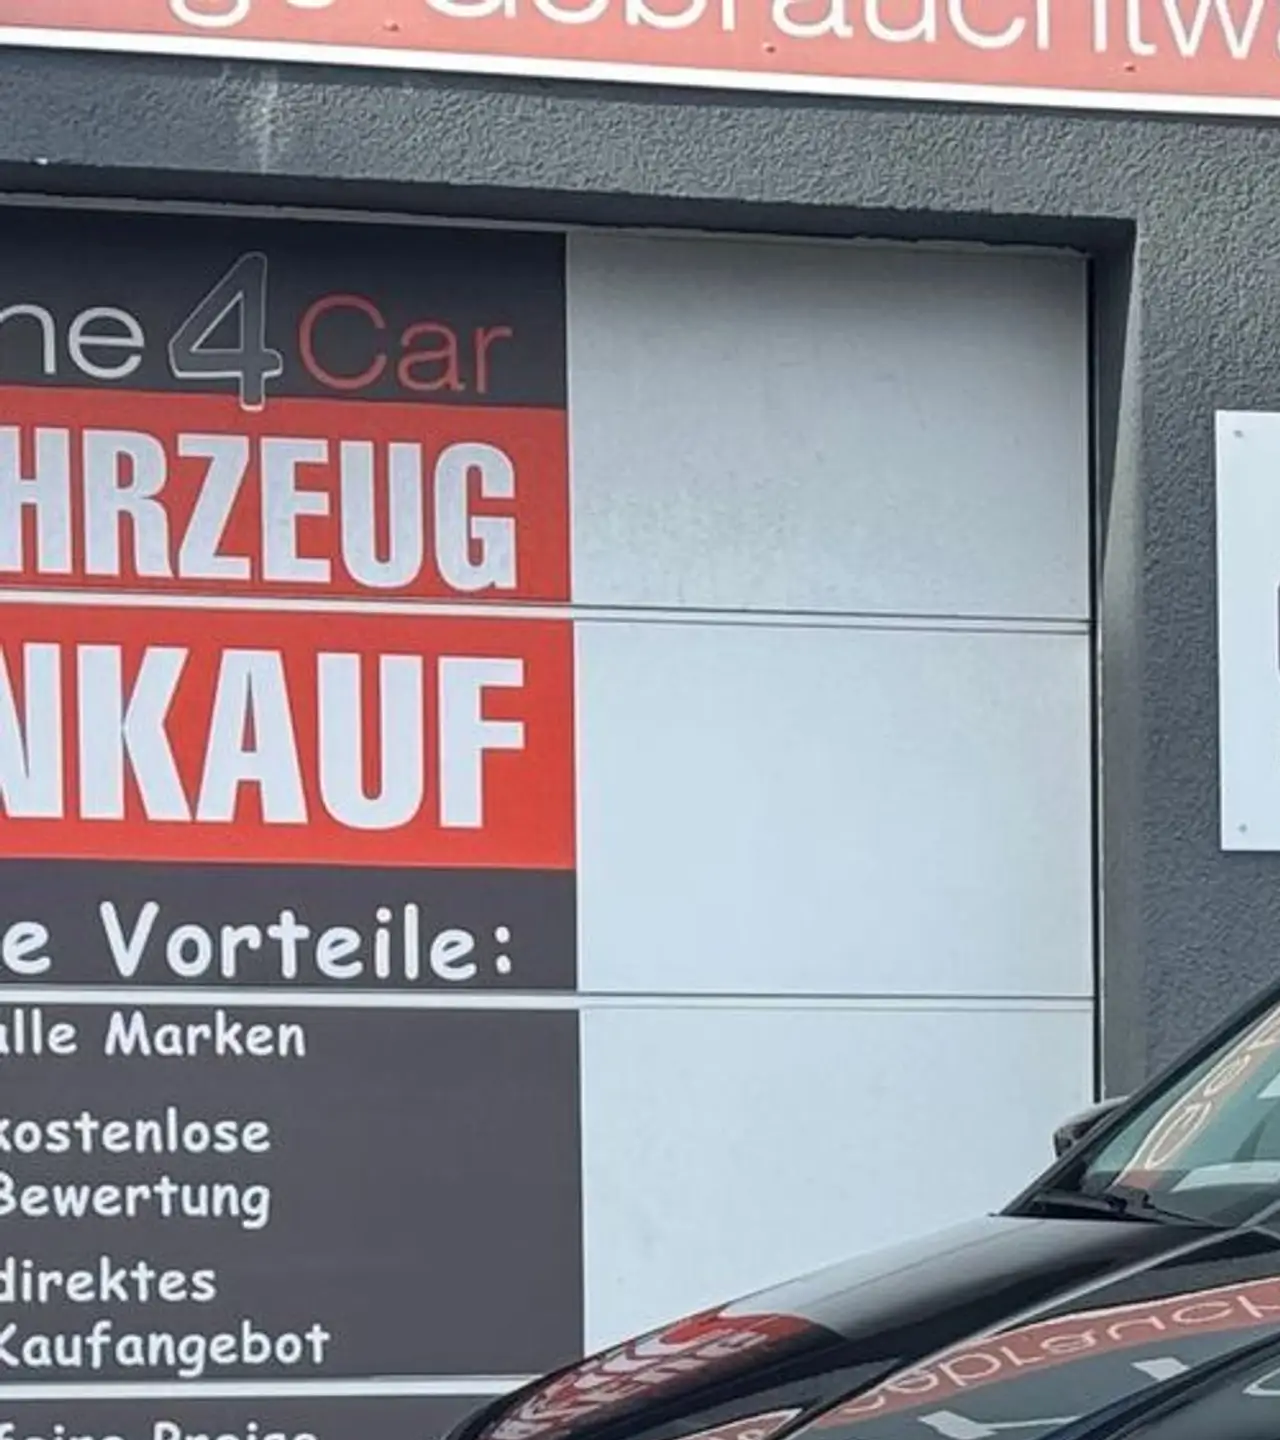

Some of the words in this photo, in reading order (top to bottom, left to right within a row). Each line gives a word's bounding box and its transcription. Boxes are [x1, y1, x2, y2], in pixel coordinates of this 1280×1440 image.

[299, 293, 512, 393] Car
[99, 900, 512, 979] Vorteile:
[104, 1008, 306, 1057] Marken
